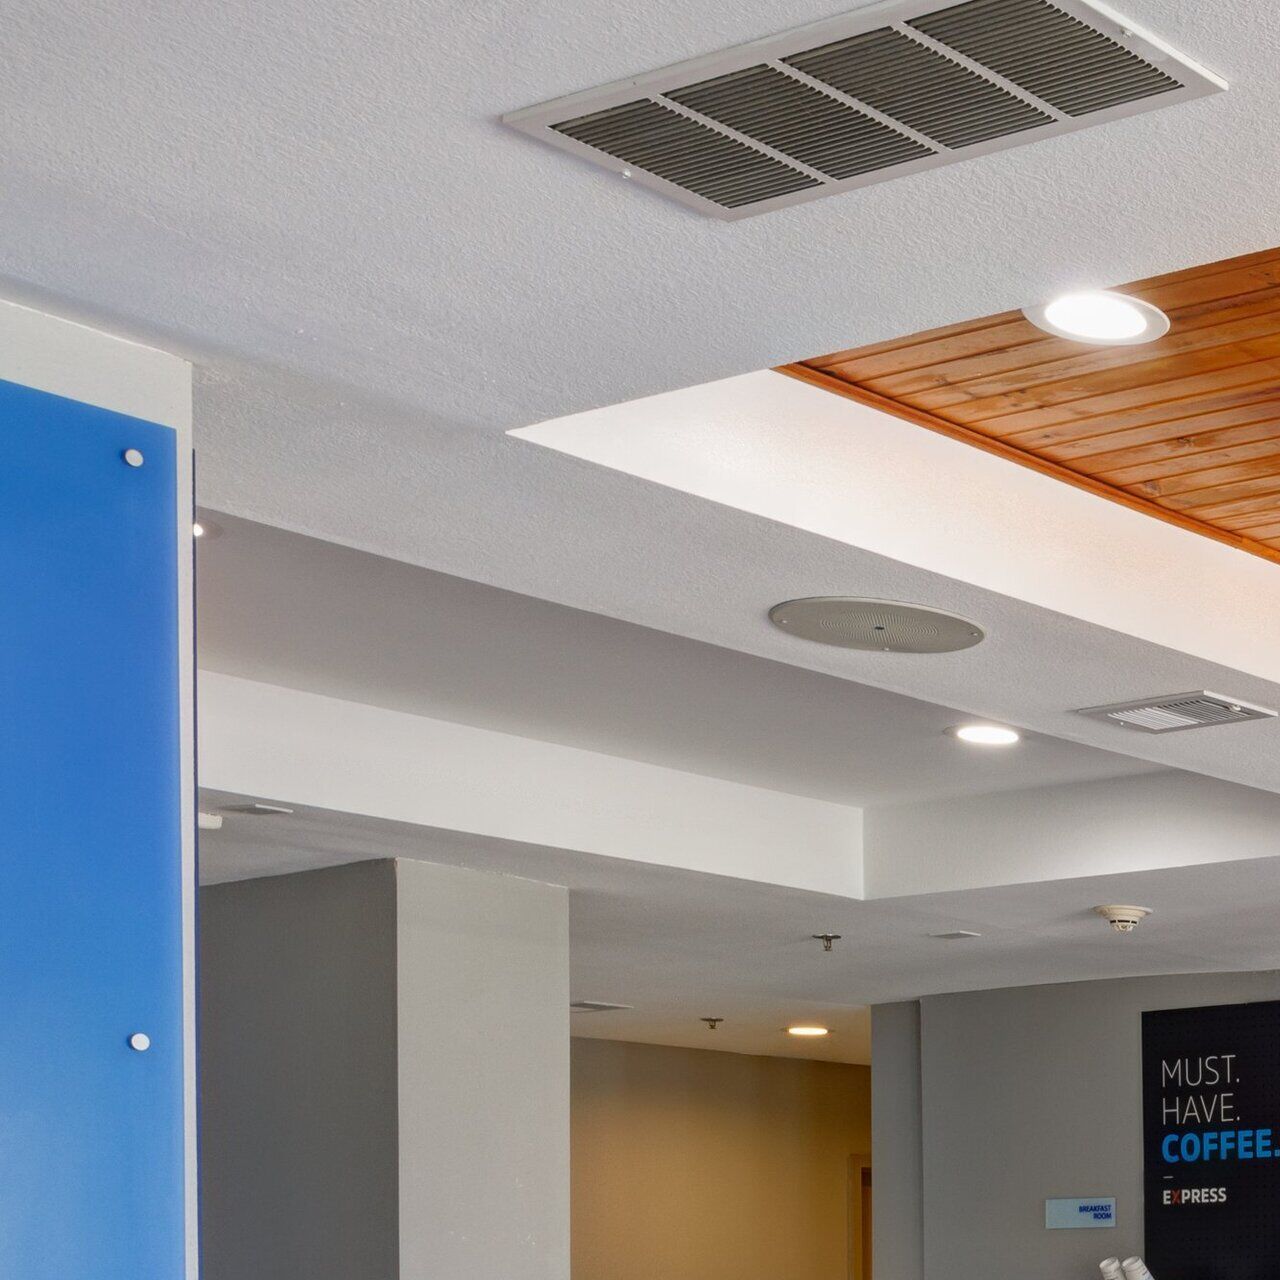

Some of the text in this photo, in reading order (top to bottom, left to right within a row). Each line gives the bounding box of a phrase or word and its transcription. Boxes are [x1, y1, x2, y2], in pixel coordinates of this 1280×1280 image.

[1162, 1054, 1240, 1088] MUST.
[1162, 1093, 1241, 1126] HAVE.
[1161, 1128, 1280, 1163] COFFEE.
[1079, 1204, 1111, 1213] BREAKFAST
[1162, 1187, 1227, 1205] EXPRESS
